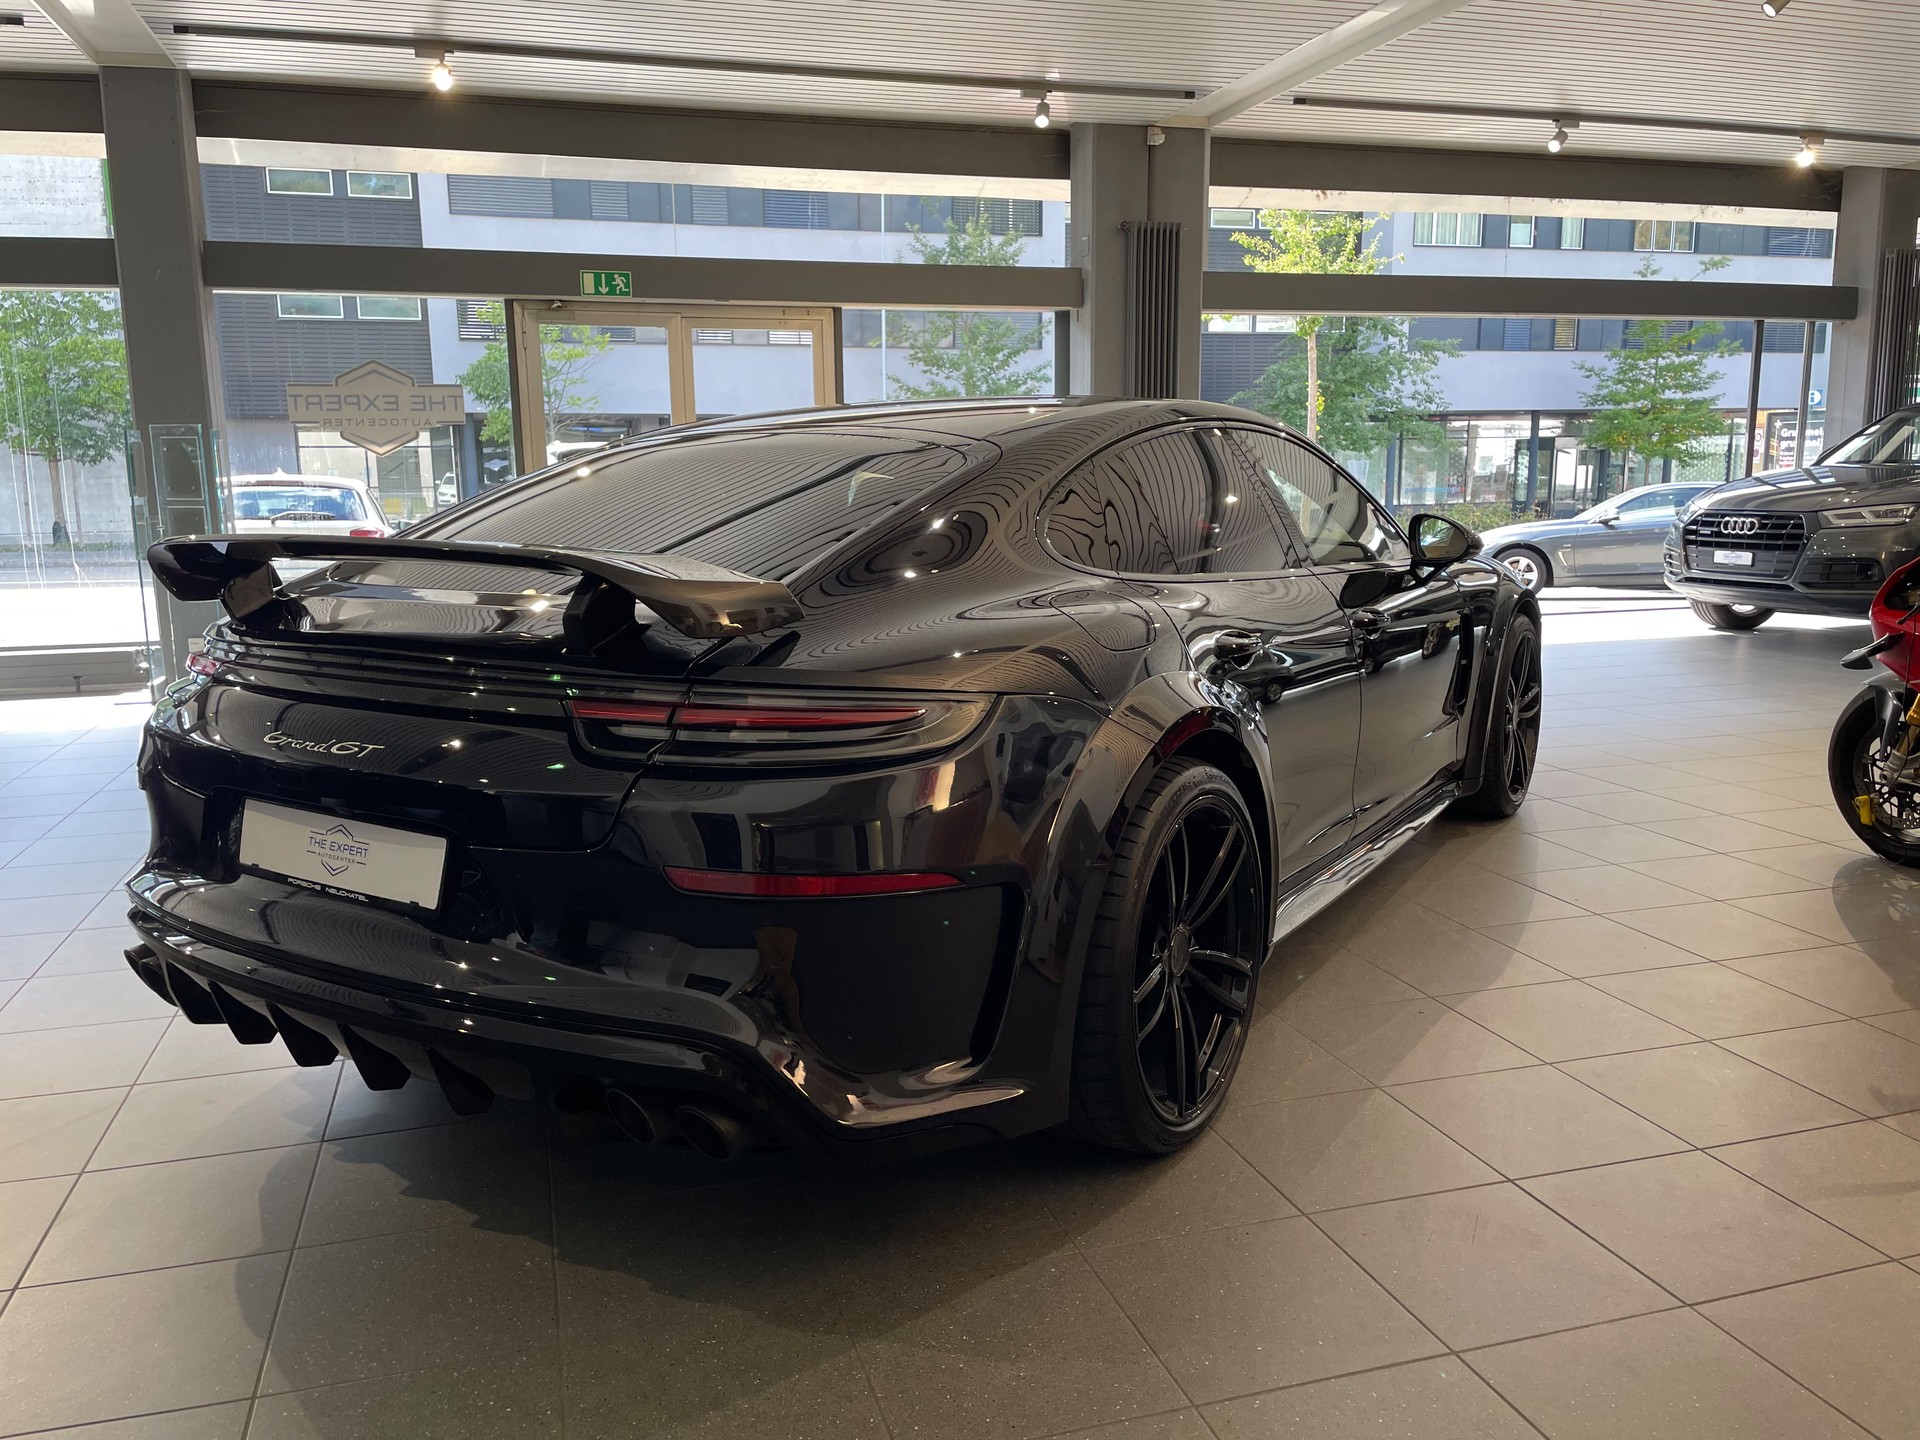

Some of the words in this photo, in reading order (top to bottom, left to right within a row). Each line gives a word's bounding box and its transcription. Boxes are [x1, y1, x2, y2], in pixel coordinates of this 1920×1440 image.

[309, 836, 328, 850] THE
[329, 841, 369, 858] EXPERT
[317, 852, 355, 864] AUTOCENTER
[287, 877, 321, 891] PORSCHE
